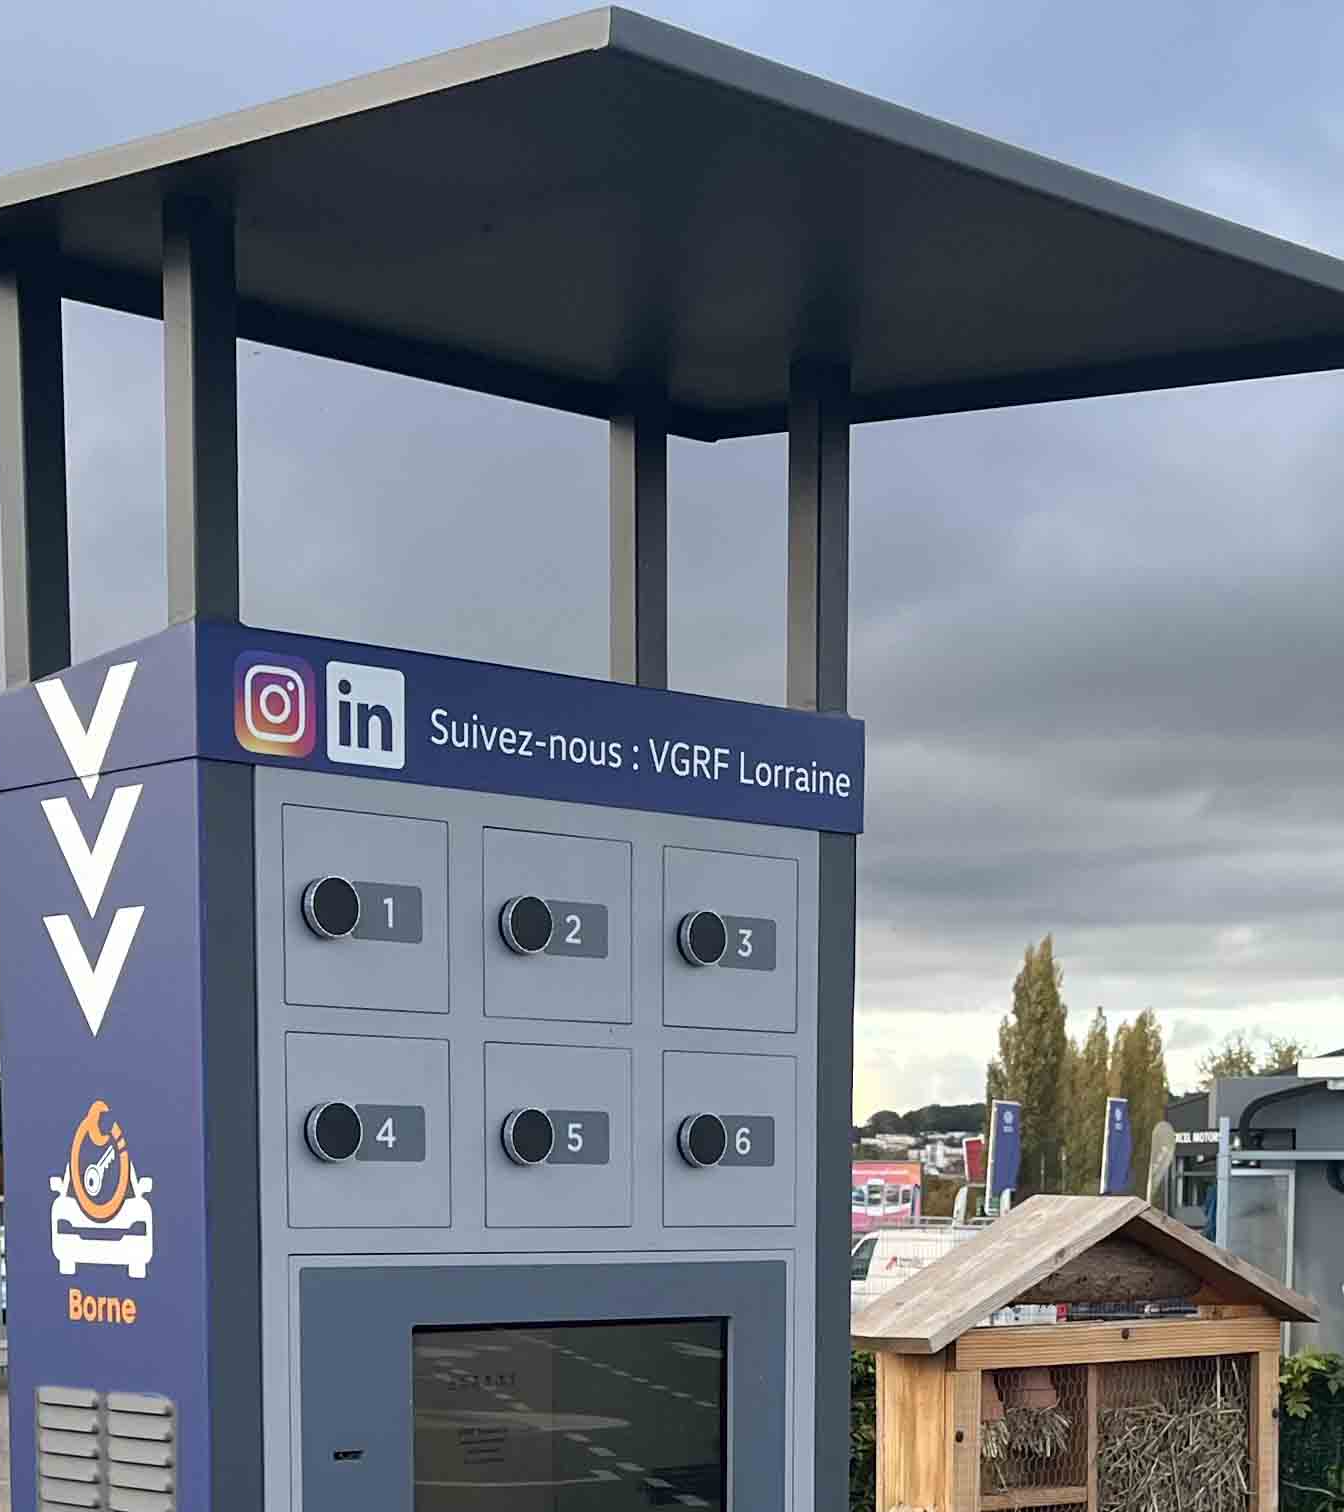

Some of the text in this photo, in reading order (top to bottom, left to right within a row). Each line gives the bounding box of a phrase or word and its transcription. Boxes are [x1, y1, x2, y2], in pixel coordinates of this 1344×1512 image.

[337, 680, 393, 752] in
[430, 708, 623, 769] Suivez-nous
[649, 738, 729, 782] VGRF
[739, 752, 852, 798] Lorraine
[383, 897, 393, 928] 1
[565, 914, 581, 945] 2
[737, 929, 753, 957] 3
[375, 1117, 396, 1148] 4
[567, 1123, 583, 1152] 5
[735, 1127, 751, 1155] 6
[69, 1287, 136, 1324] Borne
